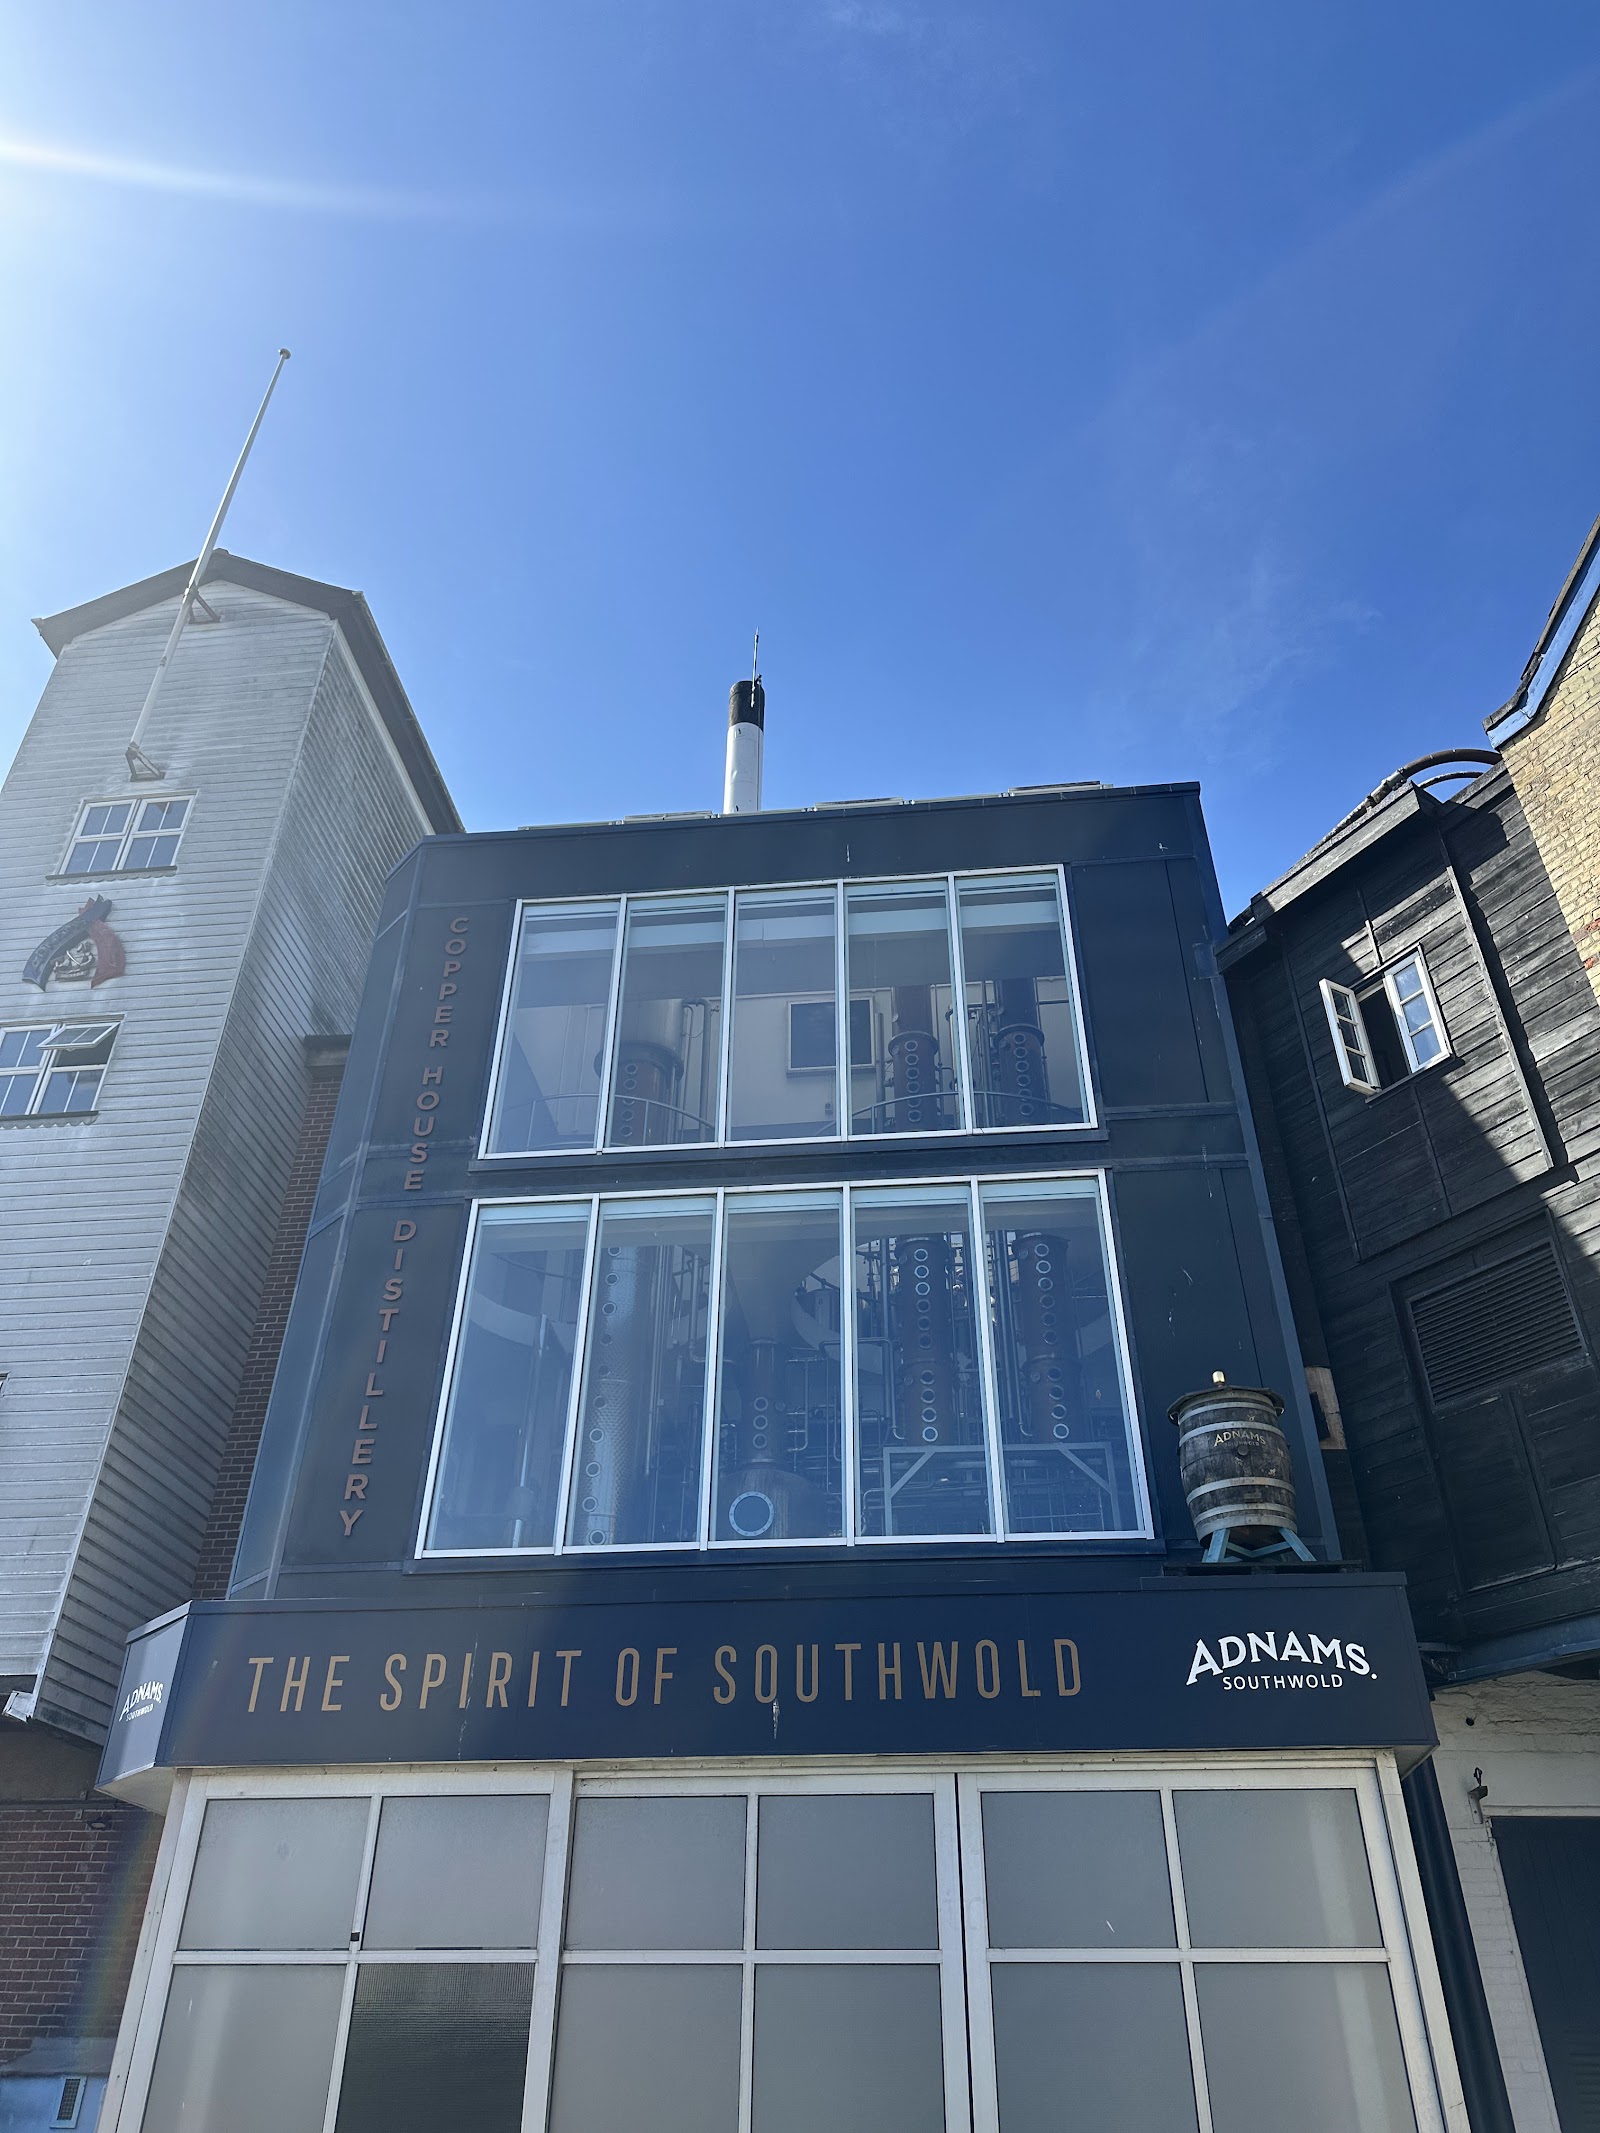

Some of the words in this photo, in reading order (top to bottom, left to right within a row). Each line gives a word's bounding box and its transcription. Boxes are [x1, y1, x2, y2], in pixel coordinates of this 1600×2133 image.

[429, 917, 469, 1048] COPPER
[403, 1065, 443, 1190] HOUSE
[339, 1219, 417, 1536] DISTILLERY
[1213, 1430, 1266, 1447] ADNAMS
[248, 1656, 350, 1713] THE
[380, 1651, 582, 1711] SPIRIT
[615, 1647, 678, 1706] OF
[713, 1639, 1082, 1704] SOUTHWOLD
[1222, 1674, 1343, 1690] SOUTHWOLD
